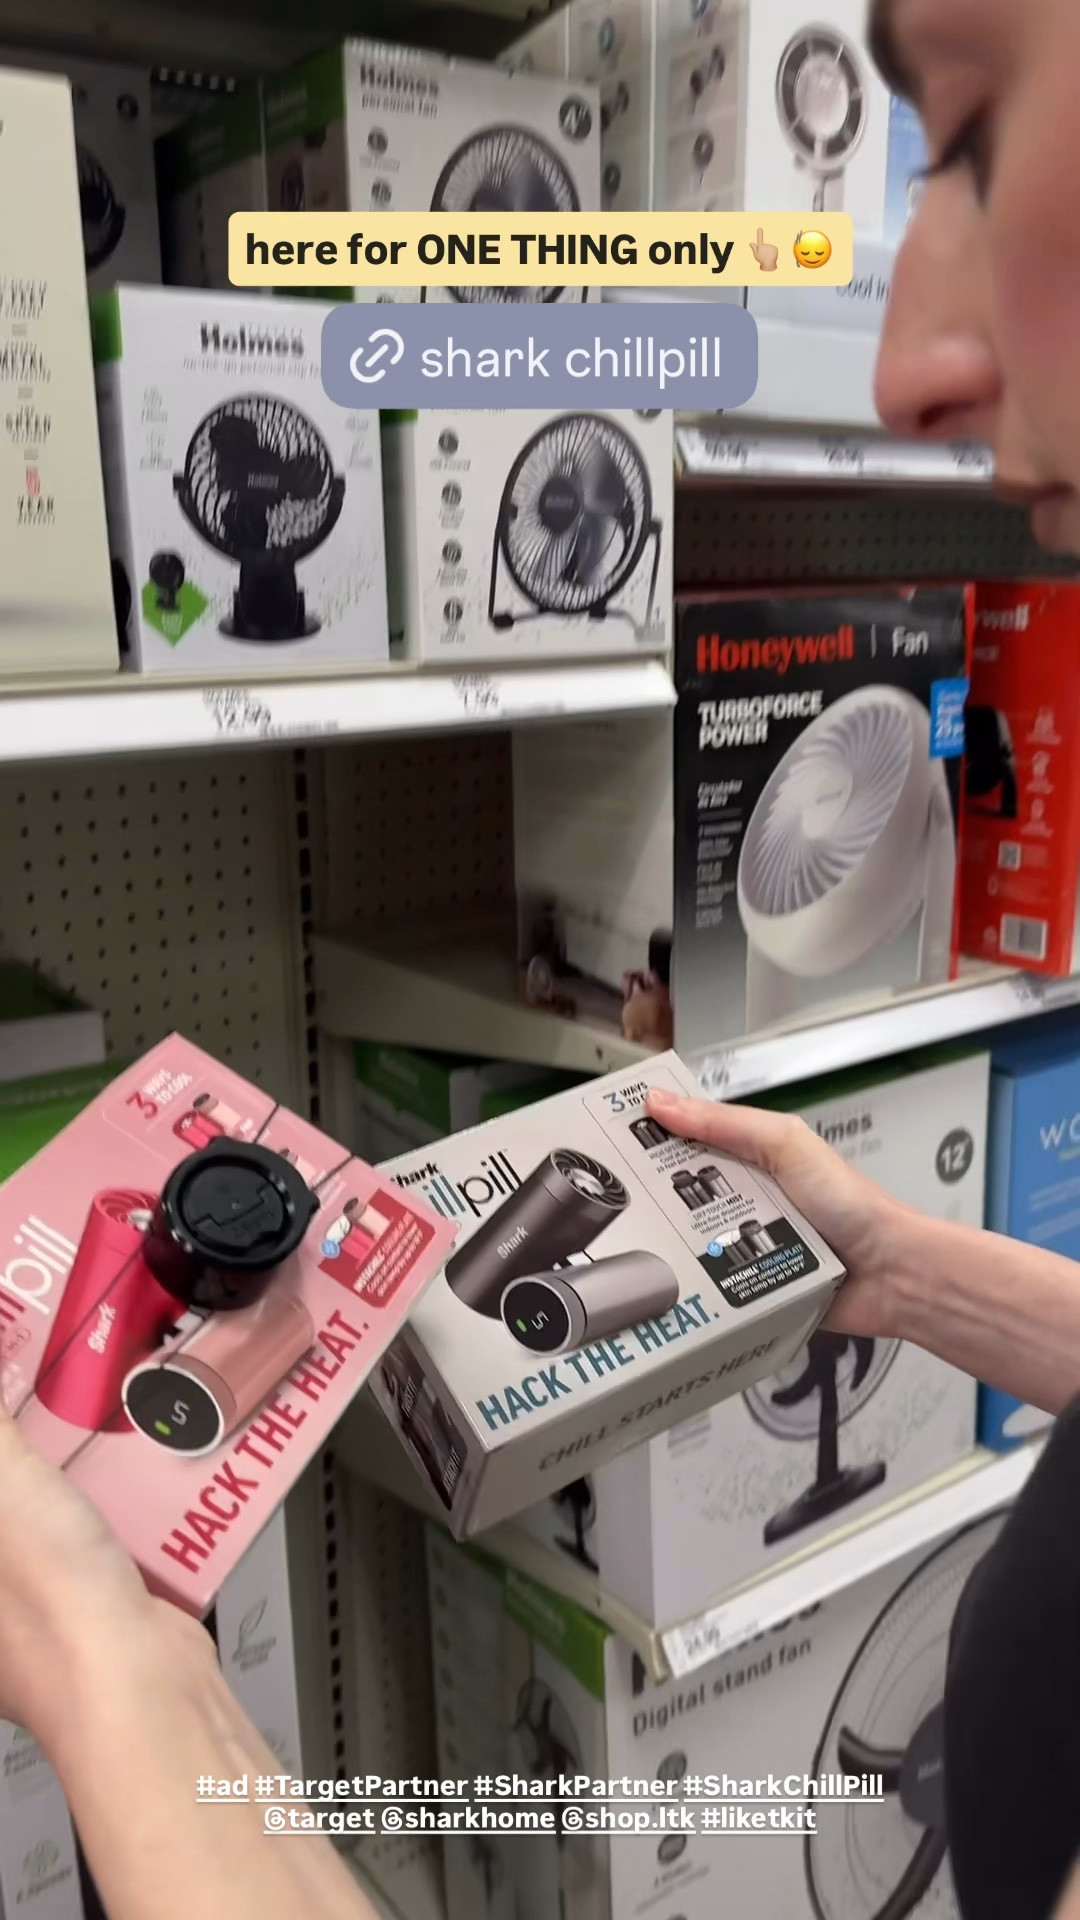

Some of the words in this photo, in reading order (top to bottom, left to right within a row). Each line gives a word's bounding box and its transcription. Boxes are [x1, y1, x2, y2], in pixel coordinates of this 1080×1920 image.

[697, 624, 855, 676] Honeywell
[892, 626, 929, 657] Fan
[697, 690, 824, 726] TURBOFORCE
[699, 721, 769, 750] POWER
[125, 1091, 158, 1120] 3
[603, 1091, 626, 1113] 3
[620, 1081, 648, 1098] WAYS
[816, 1113, 872, 1144] lmes
[391, 1161, 439, 1188] hark
[422, 1151, 523, 1218] illpill
[497, 1225, 529, 1260] Shark
[476, 1364, 573, 1431] HACK
[564, 1333, 635, 1384] THE
[632, 1293, 721, 1354] HEAT.
[160, 1460, 260, 1574] HACK
[233, 1394, 308, 1470] THE
[287, 1309, 370, 1402] HEAT.
[633, 1684, 706, 1737] Digital
[712, 1653, 773, 1696] stand
[778, 1639, 812, 1666] fan
